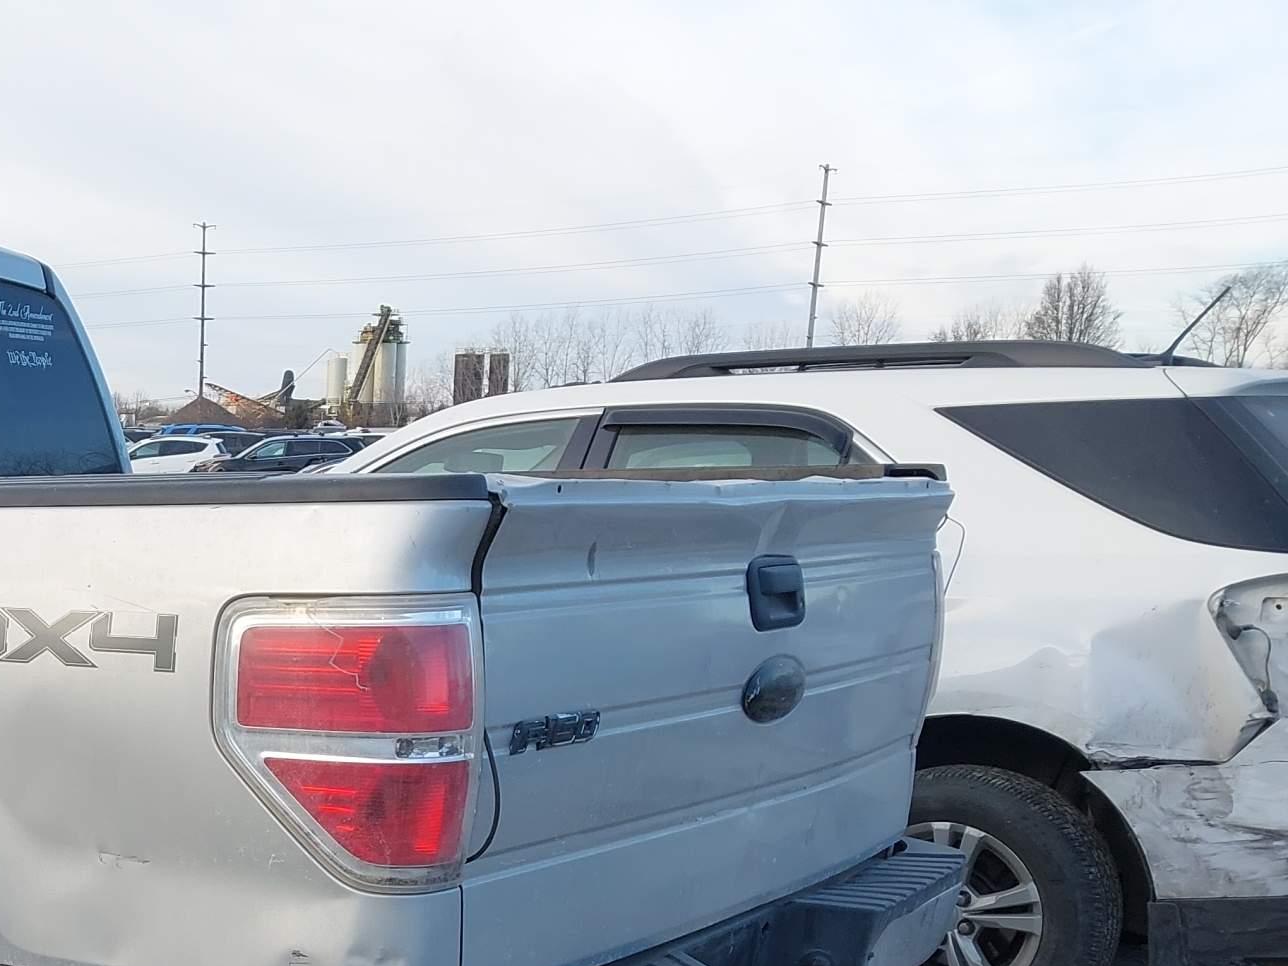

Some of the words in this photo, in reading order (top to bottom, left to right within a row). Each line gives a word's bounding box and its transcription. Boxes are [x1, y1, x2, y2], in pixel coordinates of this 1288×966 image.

[7, 303, 20, 317] 2nd
[6, 350, 19, 366] We
[28, 351, 53, 369] People
